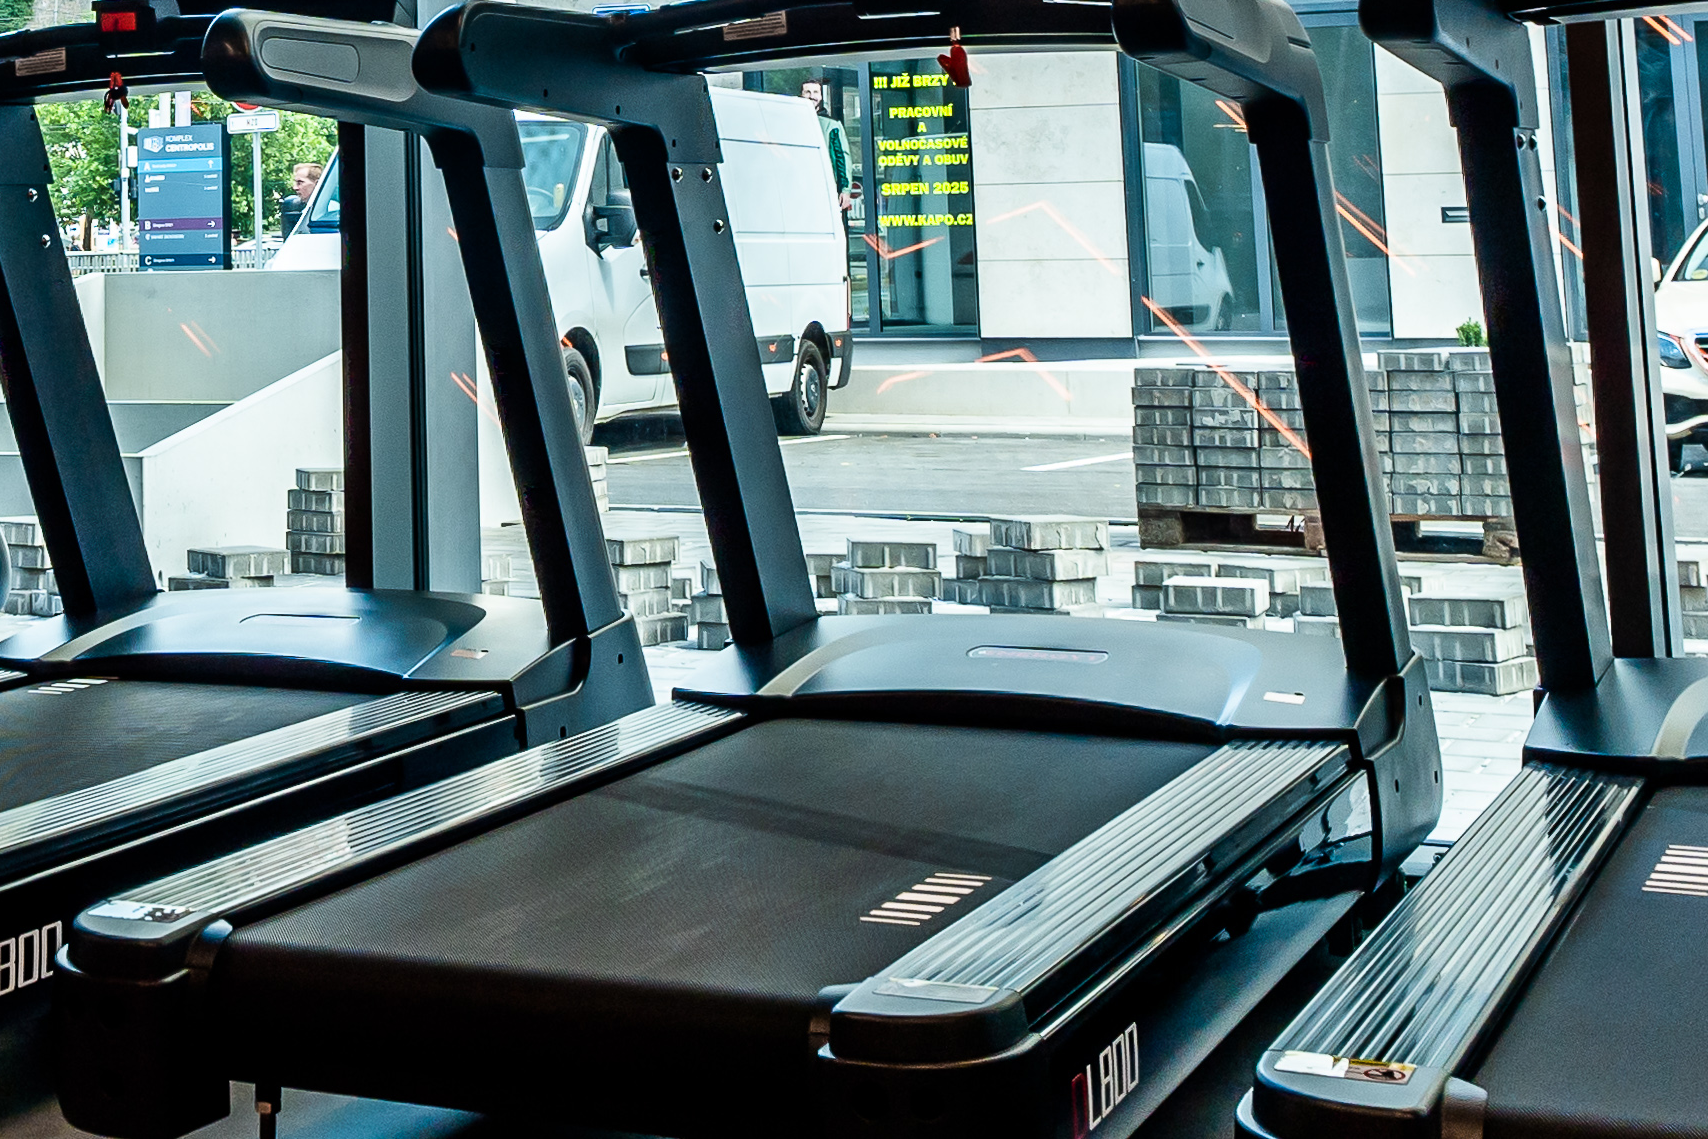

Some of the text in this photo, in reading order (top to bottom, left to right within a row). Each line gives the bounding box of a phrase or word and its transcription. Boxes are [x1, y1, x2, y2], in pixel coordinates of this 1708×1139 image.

[890, 73, 910, 88] JIŽ
[913, 74, 948, 87] BRZY
[889, 103, 953, 119] PRACOVNÍ
[917, 122, 927, 133] A
[165, 143, 214, 152] CENTROPOLIS
[878, 136, 968, 151] VOLNOČASOVÉ
[144, 162, 151, 171] A
[878, 153, 969, 167] ODĚVY A OBUV
[881, 181, 969, 196] SRPEN 2025
[144, 221, 152, 230] B
[878, 213, 973, 227] WWW.KAPO.CZ
[145, 256, 152, 265] C
[1071, 1022, 1139, 1139] DL800
